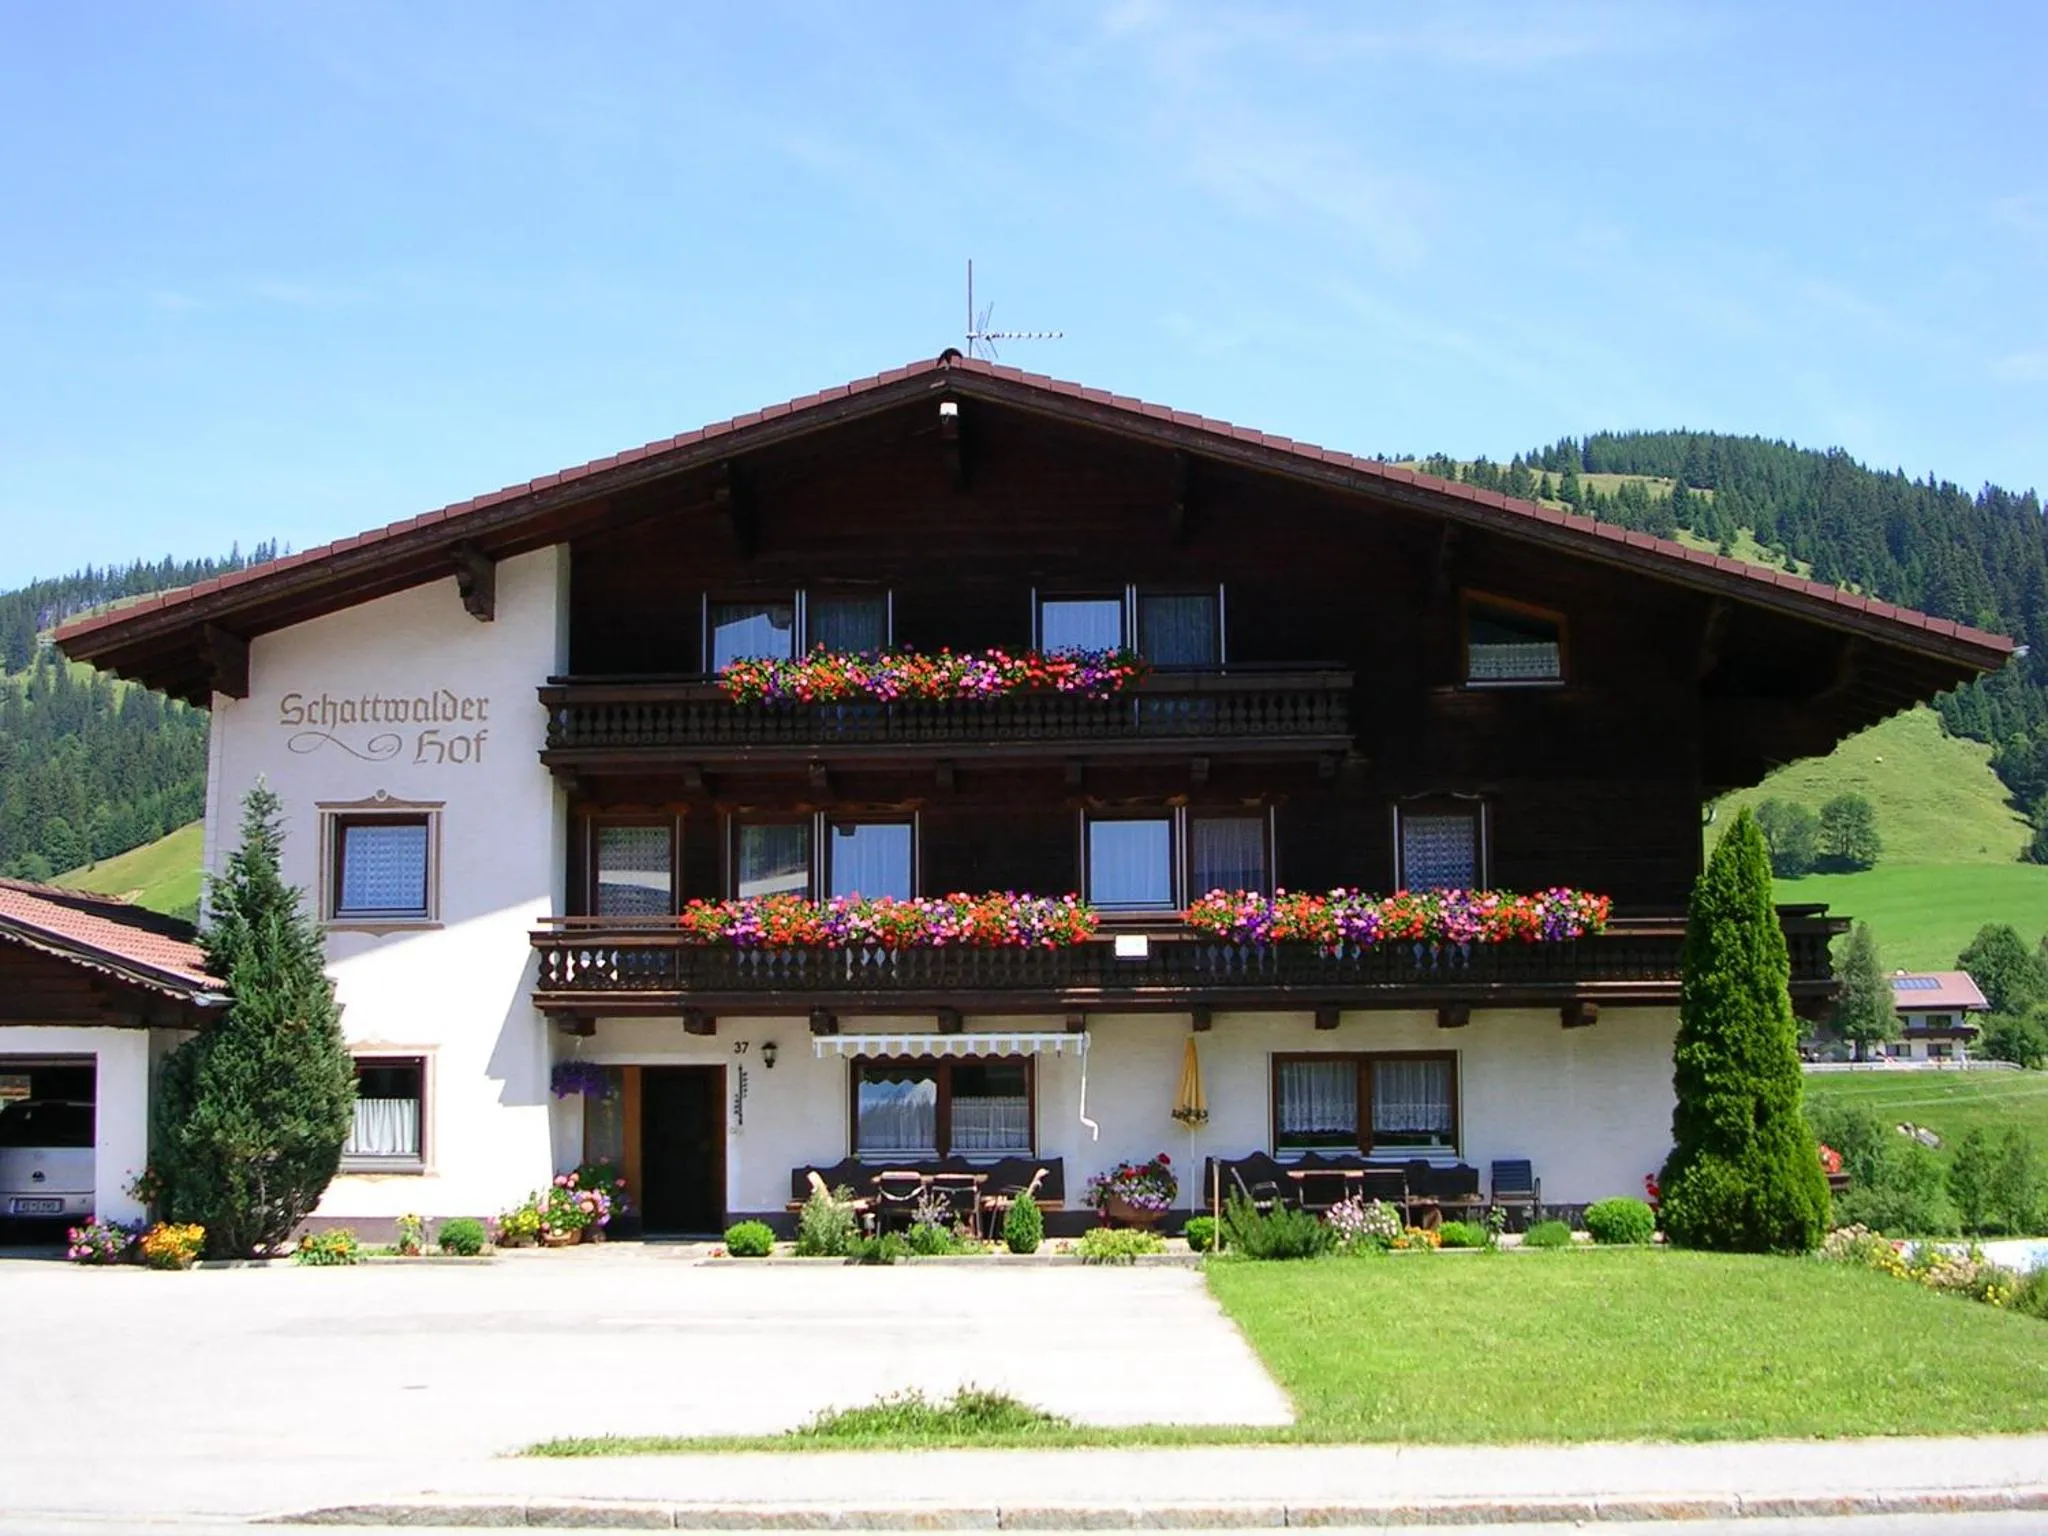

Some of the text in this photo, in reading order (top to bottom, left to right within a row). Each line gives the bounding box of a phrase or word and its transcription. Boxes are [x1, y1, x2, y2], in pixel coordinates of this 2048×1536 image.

[280, 689, 489, 729] Schattwalder
[413, 729, 488, 764] Hof
[734, 1041, 749, 1054] 37
